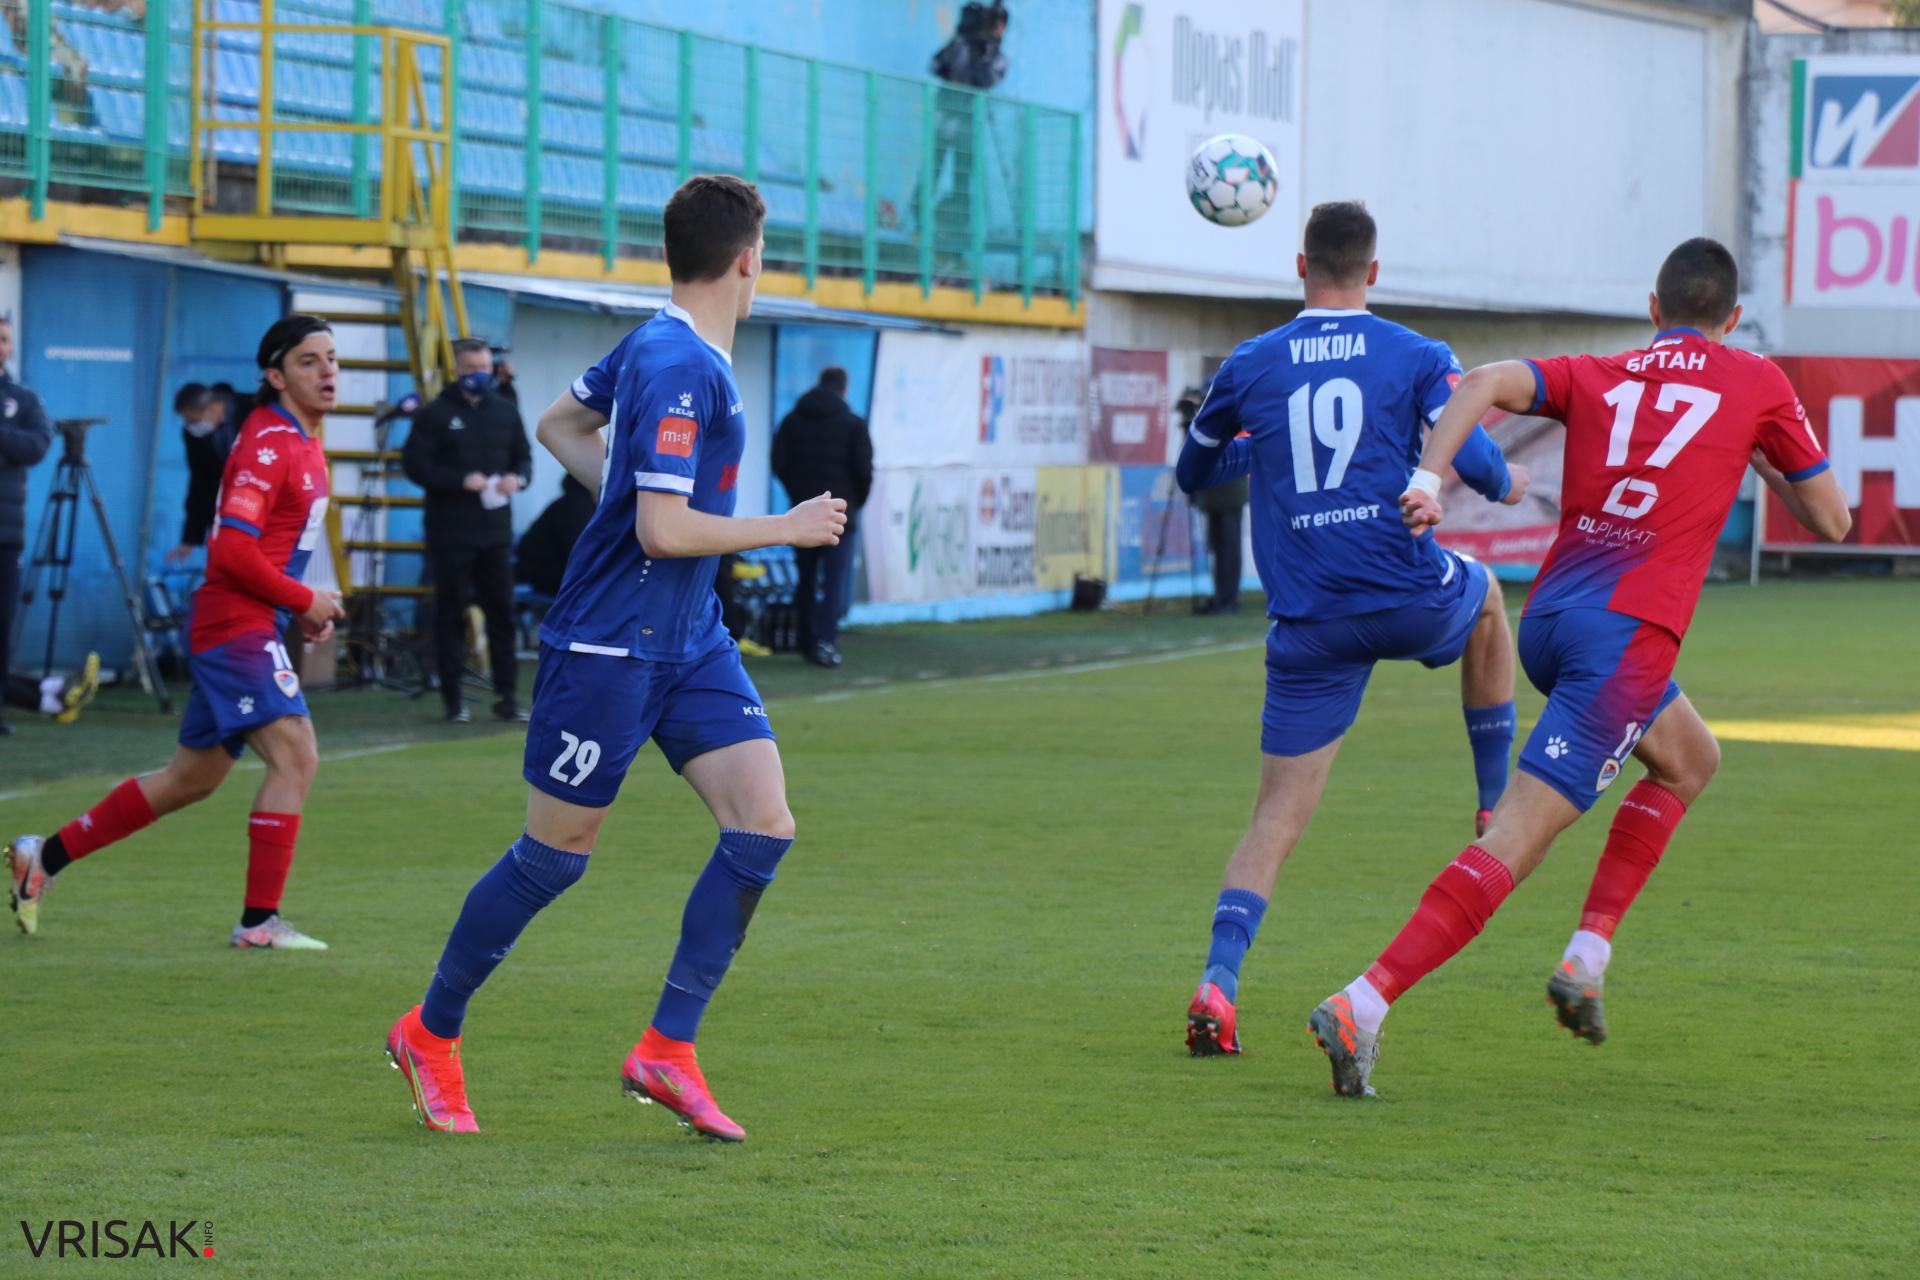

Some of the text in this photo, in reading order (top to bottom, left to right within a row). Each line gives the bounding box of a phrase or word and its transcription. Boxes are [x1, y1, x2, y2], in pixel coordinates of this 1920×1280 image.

[1289, 333, 1367, 365] VUKOJA
[1288, 377, 1364, 494] 19
[1602, 379, 1722, 469] 17
[549, 729, 601, 787] 29
